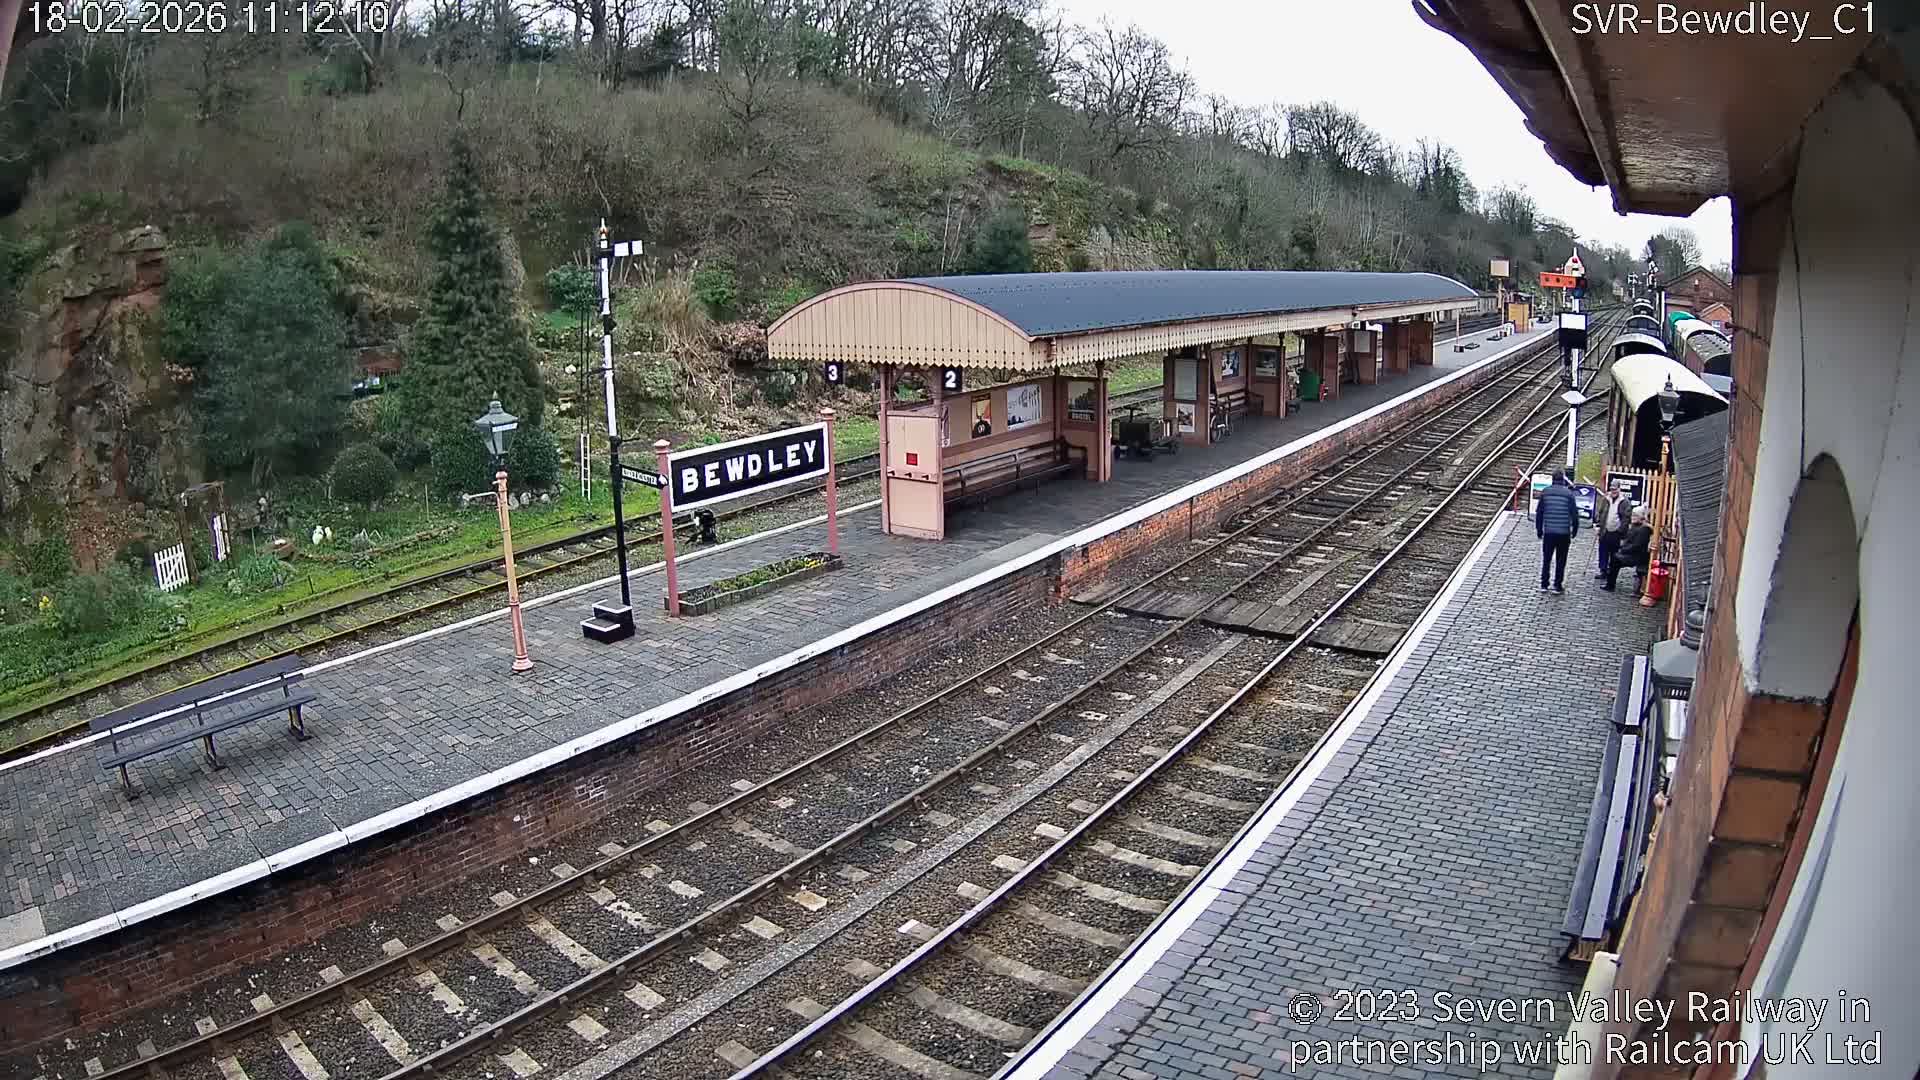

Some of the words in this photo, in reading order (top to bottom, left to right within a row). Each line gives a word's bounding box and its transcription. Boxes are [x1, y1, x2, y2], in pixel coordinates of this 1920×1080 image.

[827, 364, 838, 381] 3
[944, 370, 957, 388] 2
[681, 439, 817, 494] BEWDLEY
